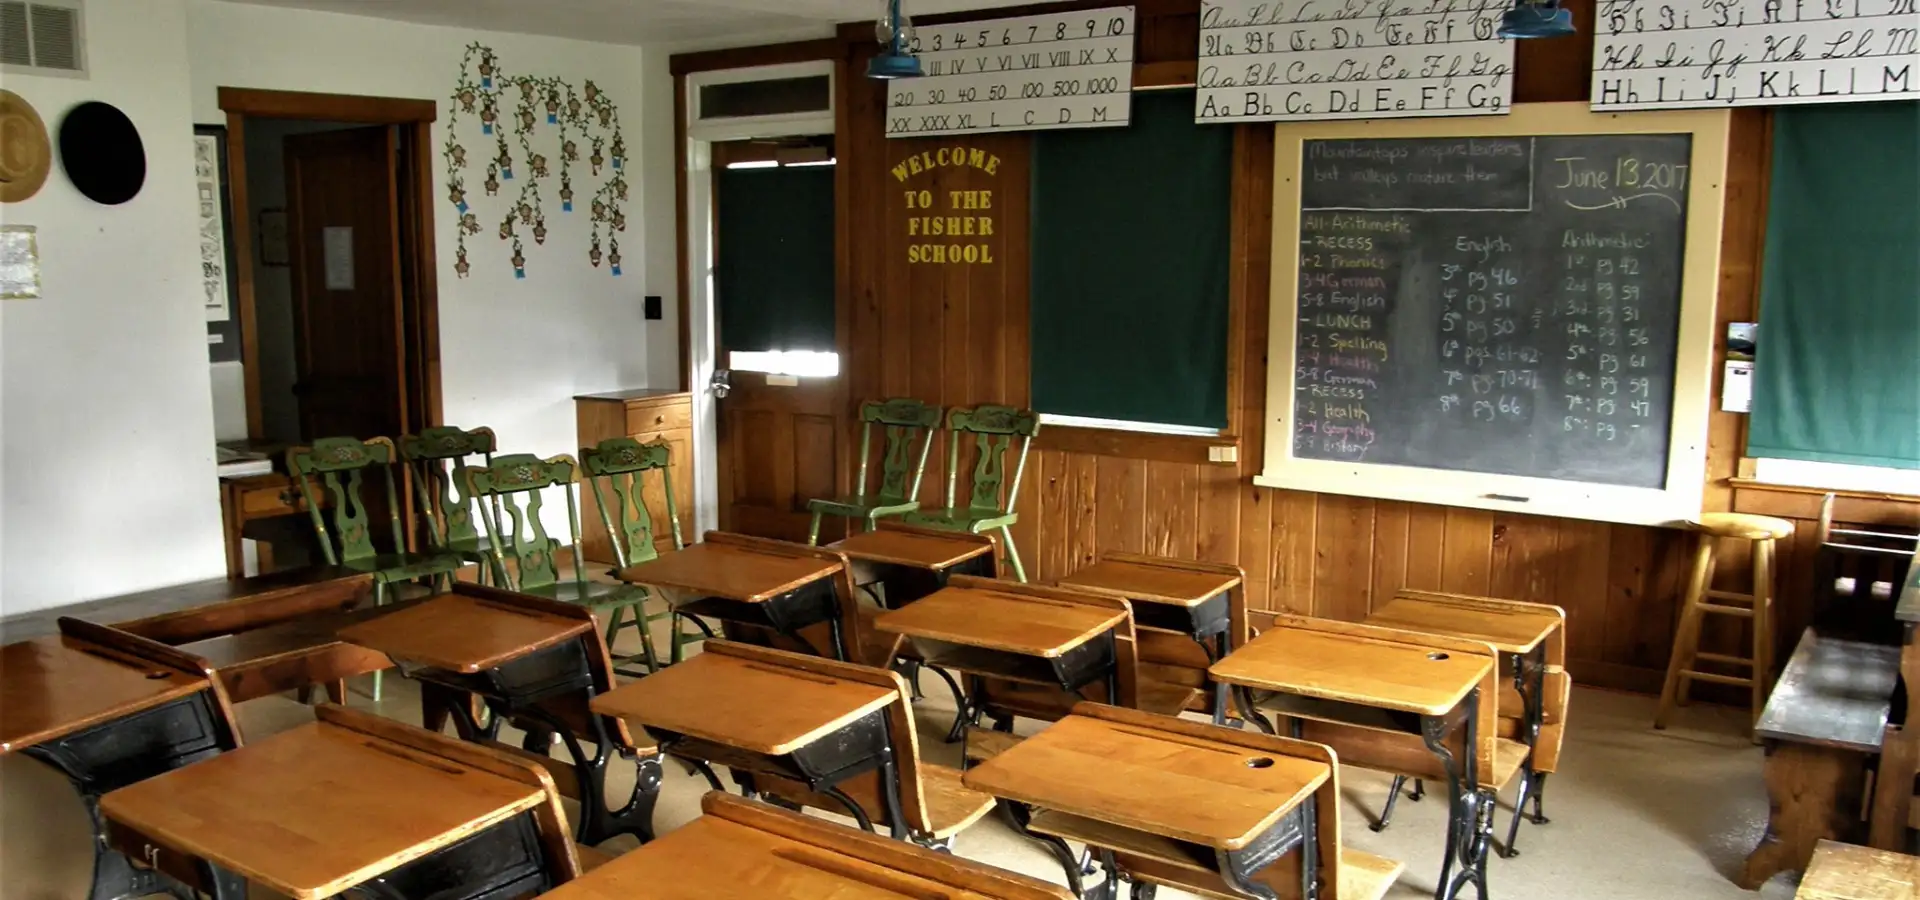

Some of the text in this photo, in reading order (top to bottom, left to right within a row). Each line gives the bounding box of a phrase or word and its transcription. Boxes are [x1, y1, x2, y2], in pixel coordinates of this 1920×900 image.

[911, 17, 1125, 53] 2 3 4 5 6 7 8 9 10
[929, 47, 1118, 76] III IV V VI VII VIII IX X
[1882, 64, 1911, 93] M
[894, 77, 1118, 107] 20 30 40 50 100 500 1000
[1201, 83, 1502, 117] Aa Bb Cc Dd Ee Ff Gg
[890, 106, 1107, 132] XX XXX XL L C D M
[890, 146, 1002, 183] WELCOME
[1554, 156, 1609, 189] June
[1642, 162, 1688, 191] 2017
[904, 189, 993, 210] TO THE
[907, 215, 994, 236] FISHER
[907, 243, 994, 264] SCHOOL
[1314, 235, 1374, 251] RECESS
[1455, 235, 1512, 264] English
[1619, 256, 1640, 275] 42
[1467, 271, 1488, 292] pg
[1491, 267, 1518, 286] 46
[1331, 291, 1386, 313] English
[1466, 293, 1487, 315] pg
[1493, 292, 1511, 309] 51
[1315, 314, 1372, 330] LUNCH
[1622, 306, 1640, 323] 31
[1466, 320, 1488, 344] pg
[1493, 317, 1516, 337] 50
[1629, 327, 1650, 347] 56
[1328, 332, 1388, 362] Spelling
[1600, 353, 1619, 374] pg
[1630, 354, 1646, 368] 61
[1324, 368, 1378, 390] German
[1601, 376, 1619, 396] pg
[1629, 377, 1650, 398] 59
[1310, 383, 1365, 400] RECESS
[1324, 402, 1371, 424] Health
[1473, 400, 1495, 423] pg
[1498, 395, 1521, 416] 66
[1597, 398, 1616, 417] pg
[1630, 399, 1650, 418] 47
[1596, 421, 1616, 442] pg
